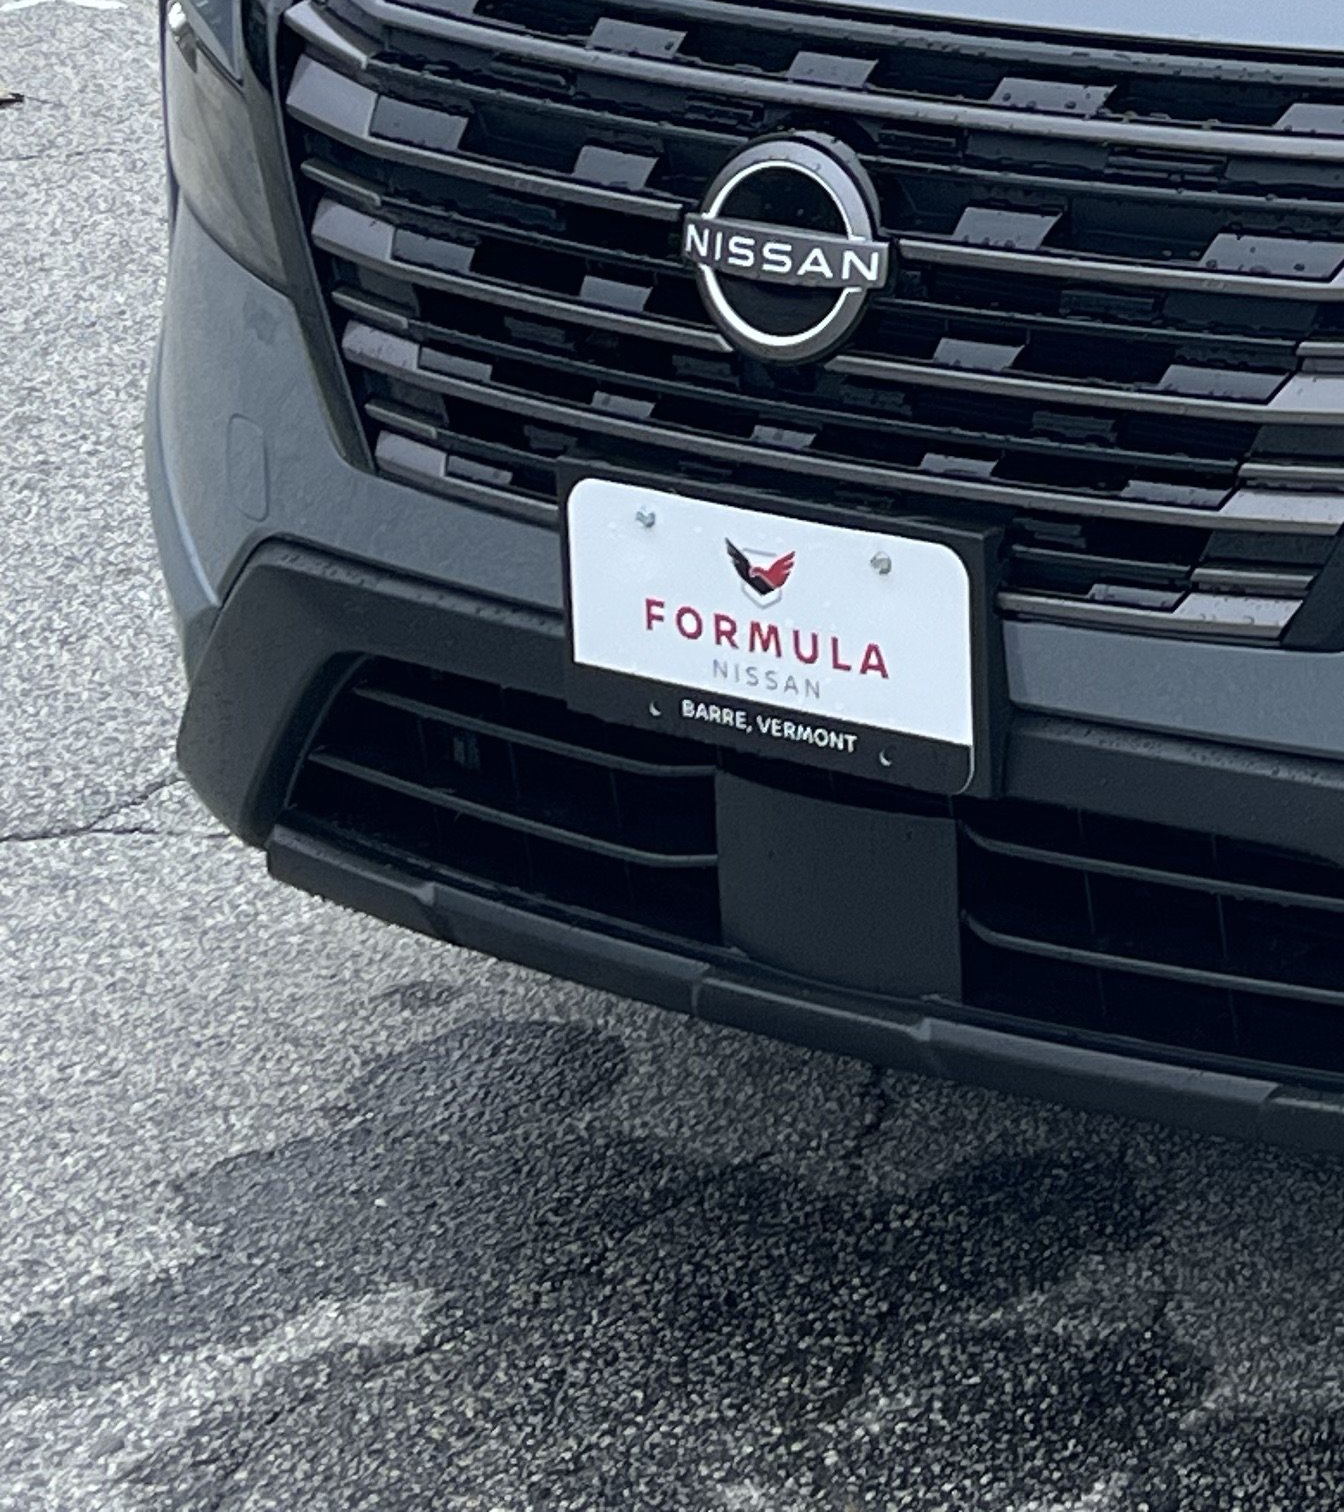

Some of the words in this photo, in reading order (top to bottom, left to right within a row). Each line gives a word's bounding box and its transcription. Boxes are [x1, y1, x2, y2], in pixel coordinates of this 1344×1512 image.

[685, 224, 879, 281] NISSAN
[645, 598, 889, 680] FORMULA
[713, 659, 821, 699] NISSAN
[681, 699, 753, 734] BARRE,
[756, 715, 858, 753] VERMONT
